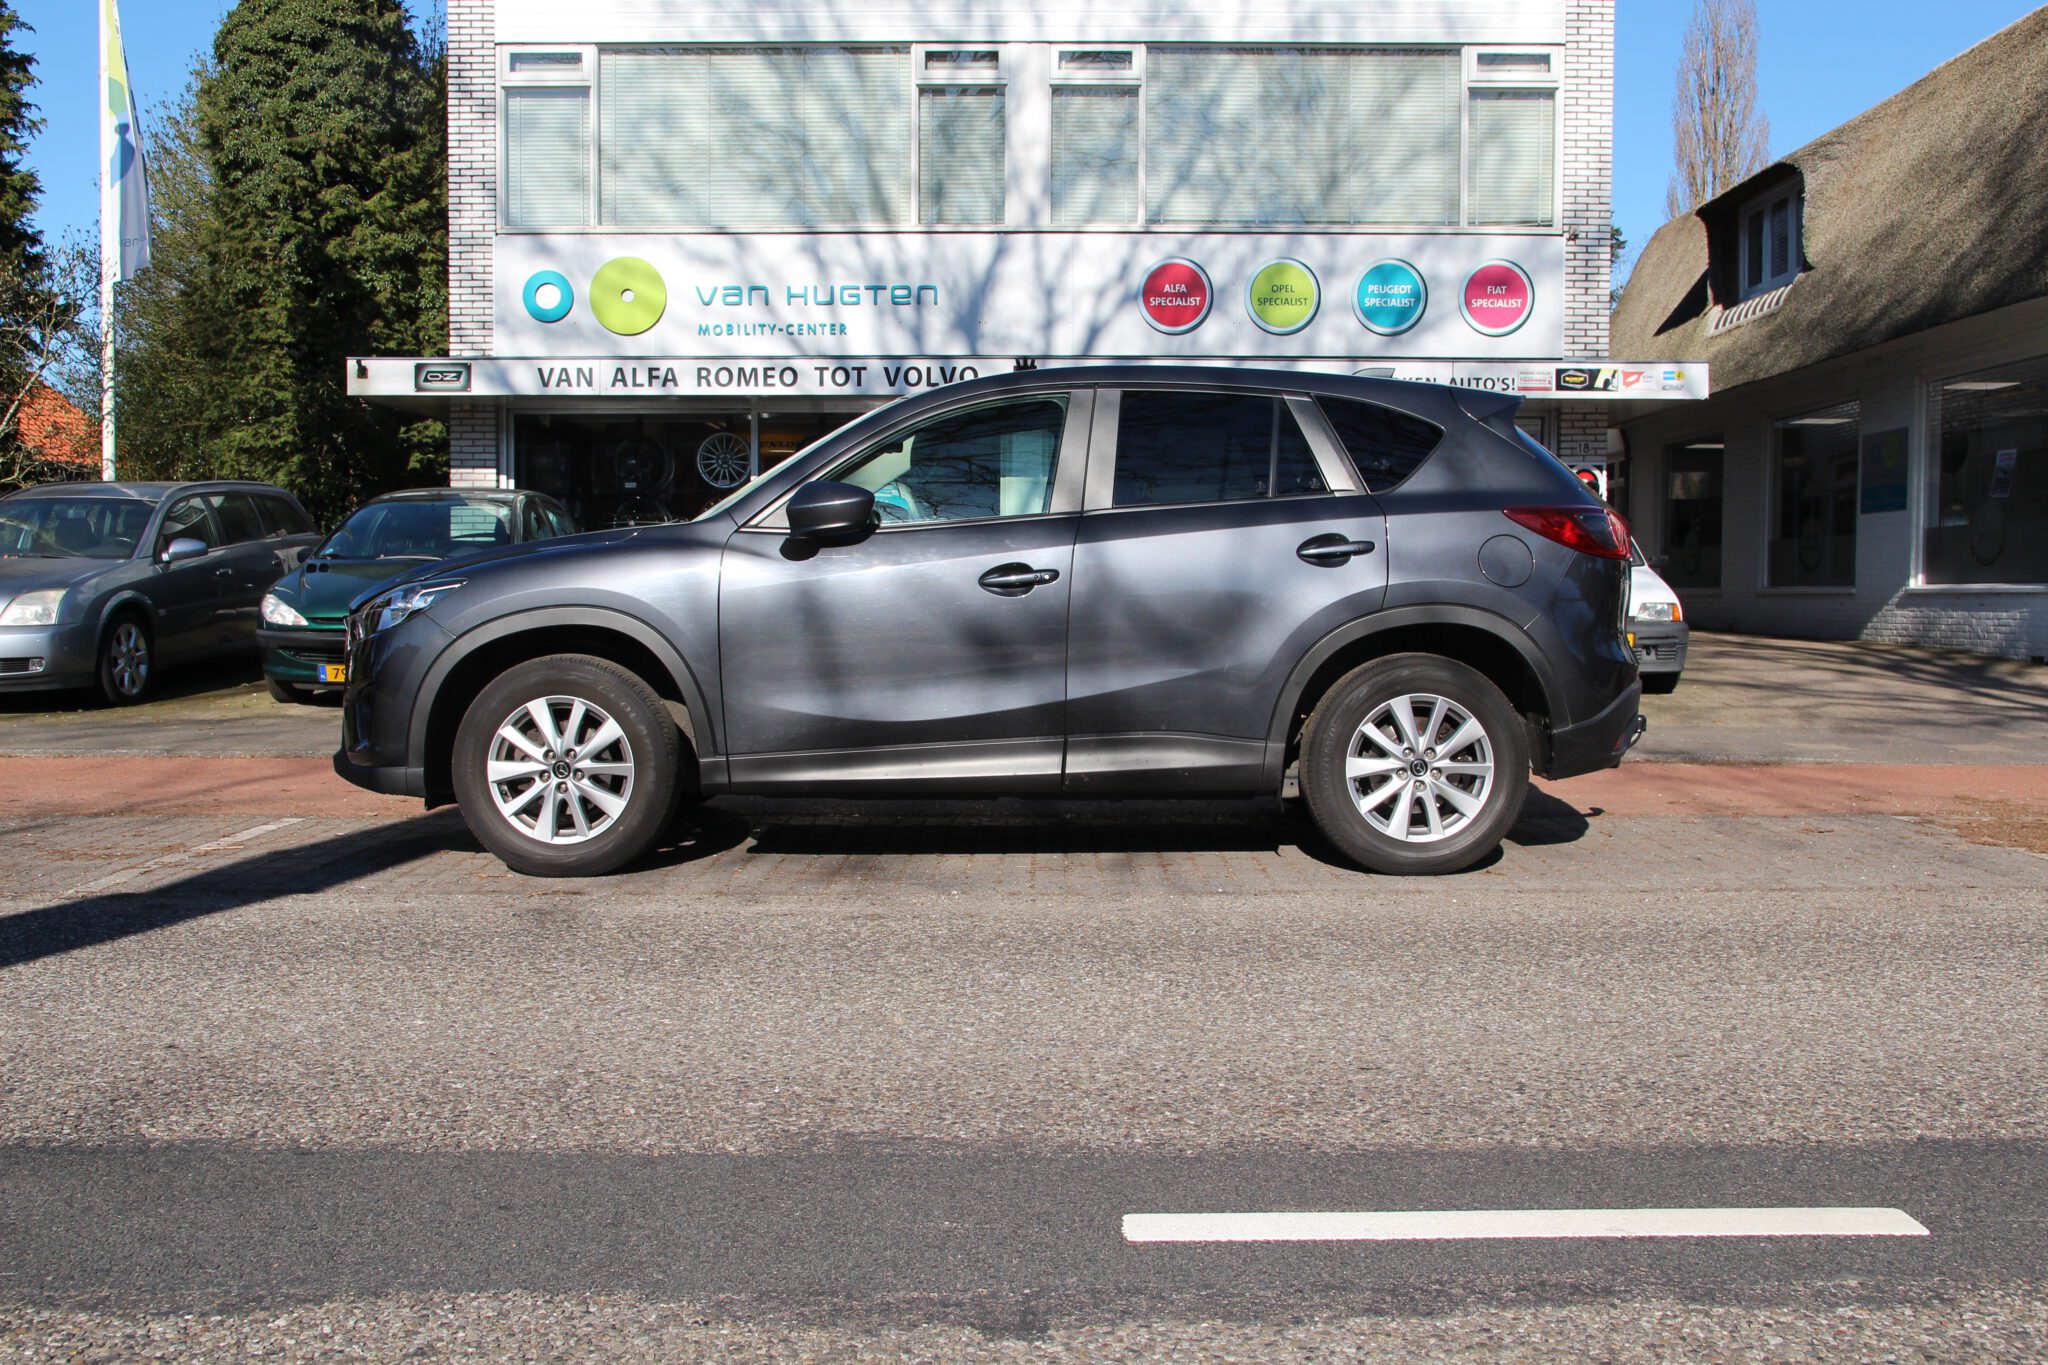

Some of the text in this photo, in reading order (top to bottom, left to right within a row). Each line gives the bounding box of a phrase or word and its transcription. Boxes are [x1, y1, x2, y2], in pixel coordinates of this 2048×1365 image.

[1163, 283, 1187, 293] ALFA
[1271, 284, 1296, 293] OPEL
[1367, 284, 1413, 294] PEUGEOT
[1487, 285, 1507, 295] FIAT
[1149, 297, 1201, 306] SPECIALIST
[1257, 297, 1309, 306] SPECIALIST
[1364, 297, 1416, 307] SPECIALIST
[1471, 298, 1523, 308] SPECIALIST
[697, 322, 848, 337] MOBILITY-CENTER
[537, 366, 979, 388] VAN ALFA ROMEO TOT VOLVO
[1578, 442, 1591, 454] 18
